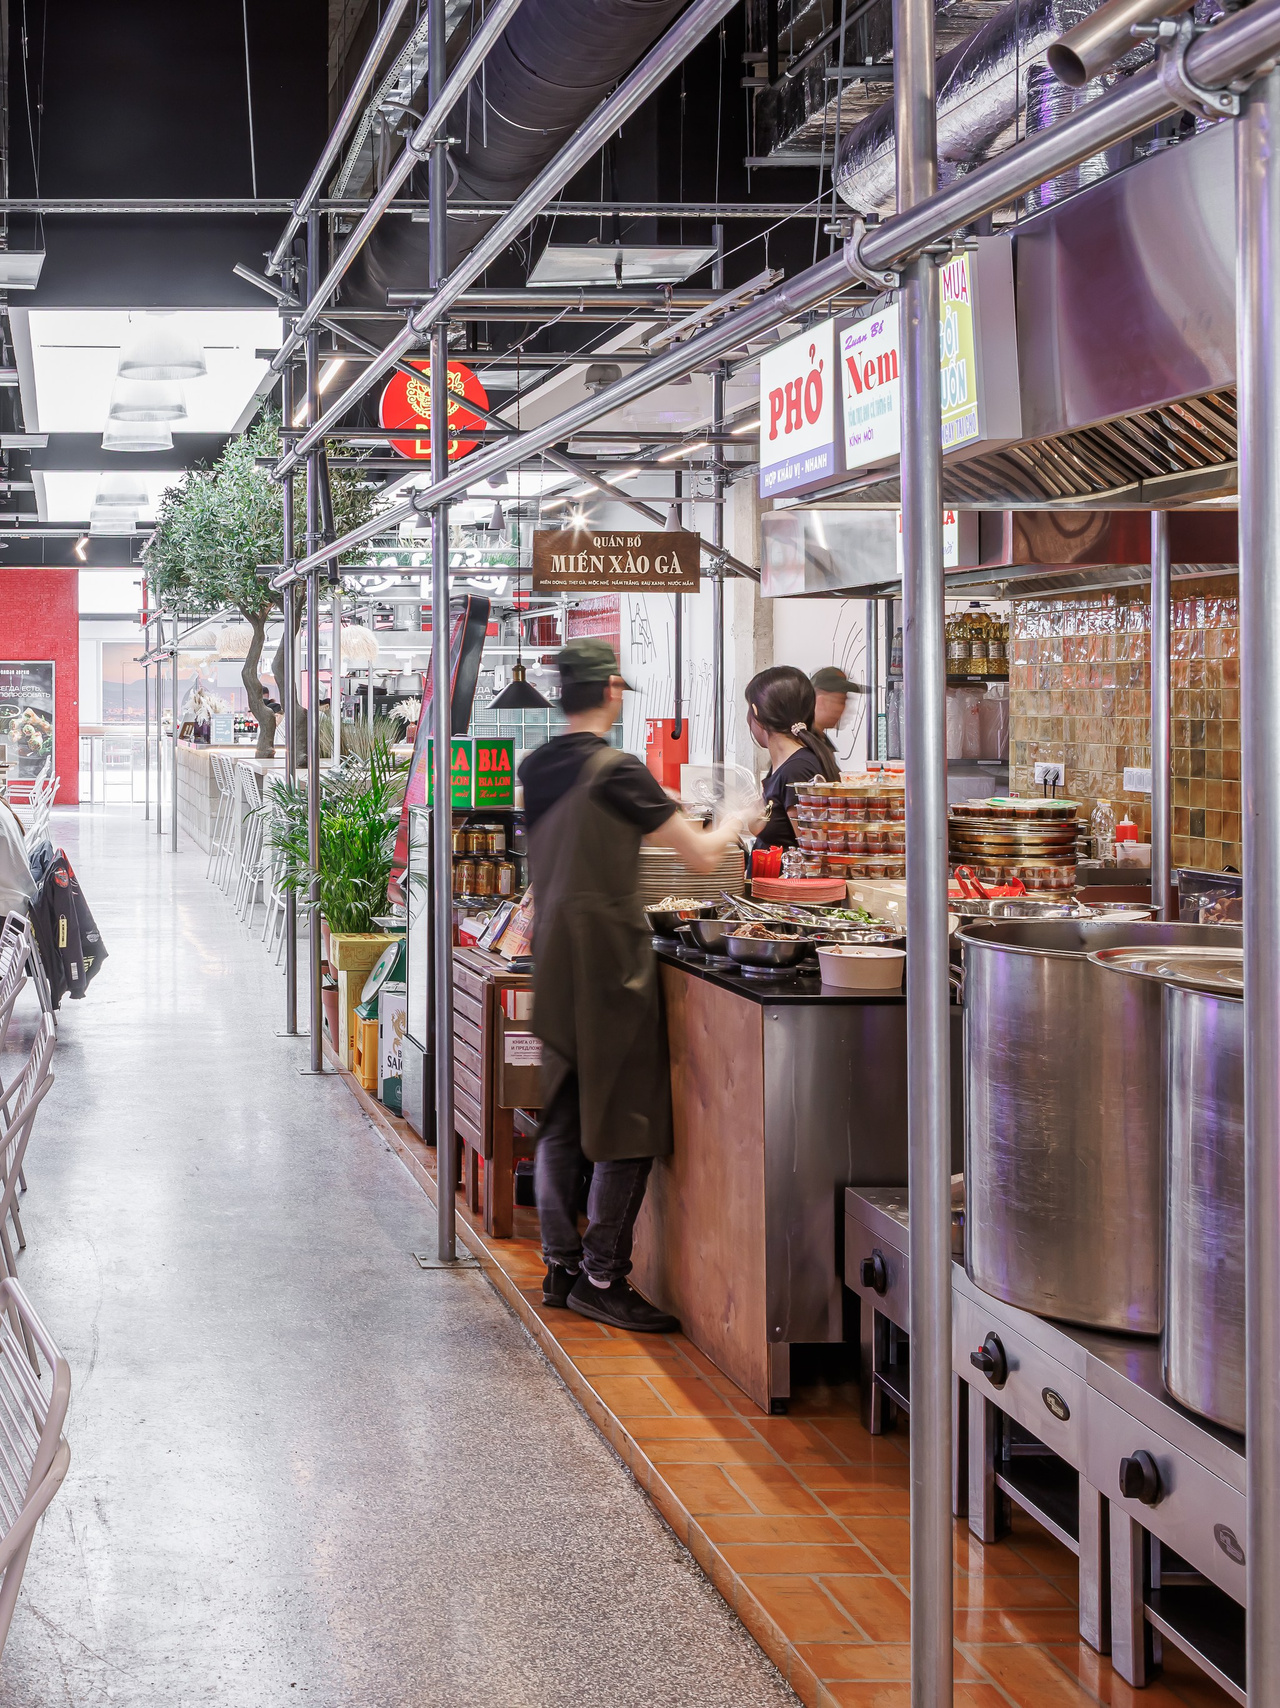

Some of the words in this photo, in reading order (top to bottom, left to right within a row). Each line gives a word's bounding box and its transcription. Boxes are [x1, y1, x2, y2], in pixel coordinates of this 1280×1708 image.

[845, 348, 899, 399] Nem
[769, 343, 824, 441] PHỞ
[805, 453, 828, 474] NHANH
[593, 536, 624, 548] QUÁN
[550, 550, 605, 573] MIẾN
[609, 550, 650, 574] XÀO
[654, 551, 683, 574] GÀ
[478, 748, 511, 772] BIA
[478, 777, 493, 787] BIA
[494, 776, 511, 786] LON
